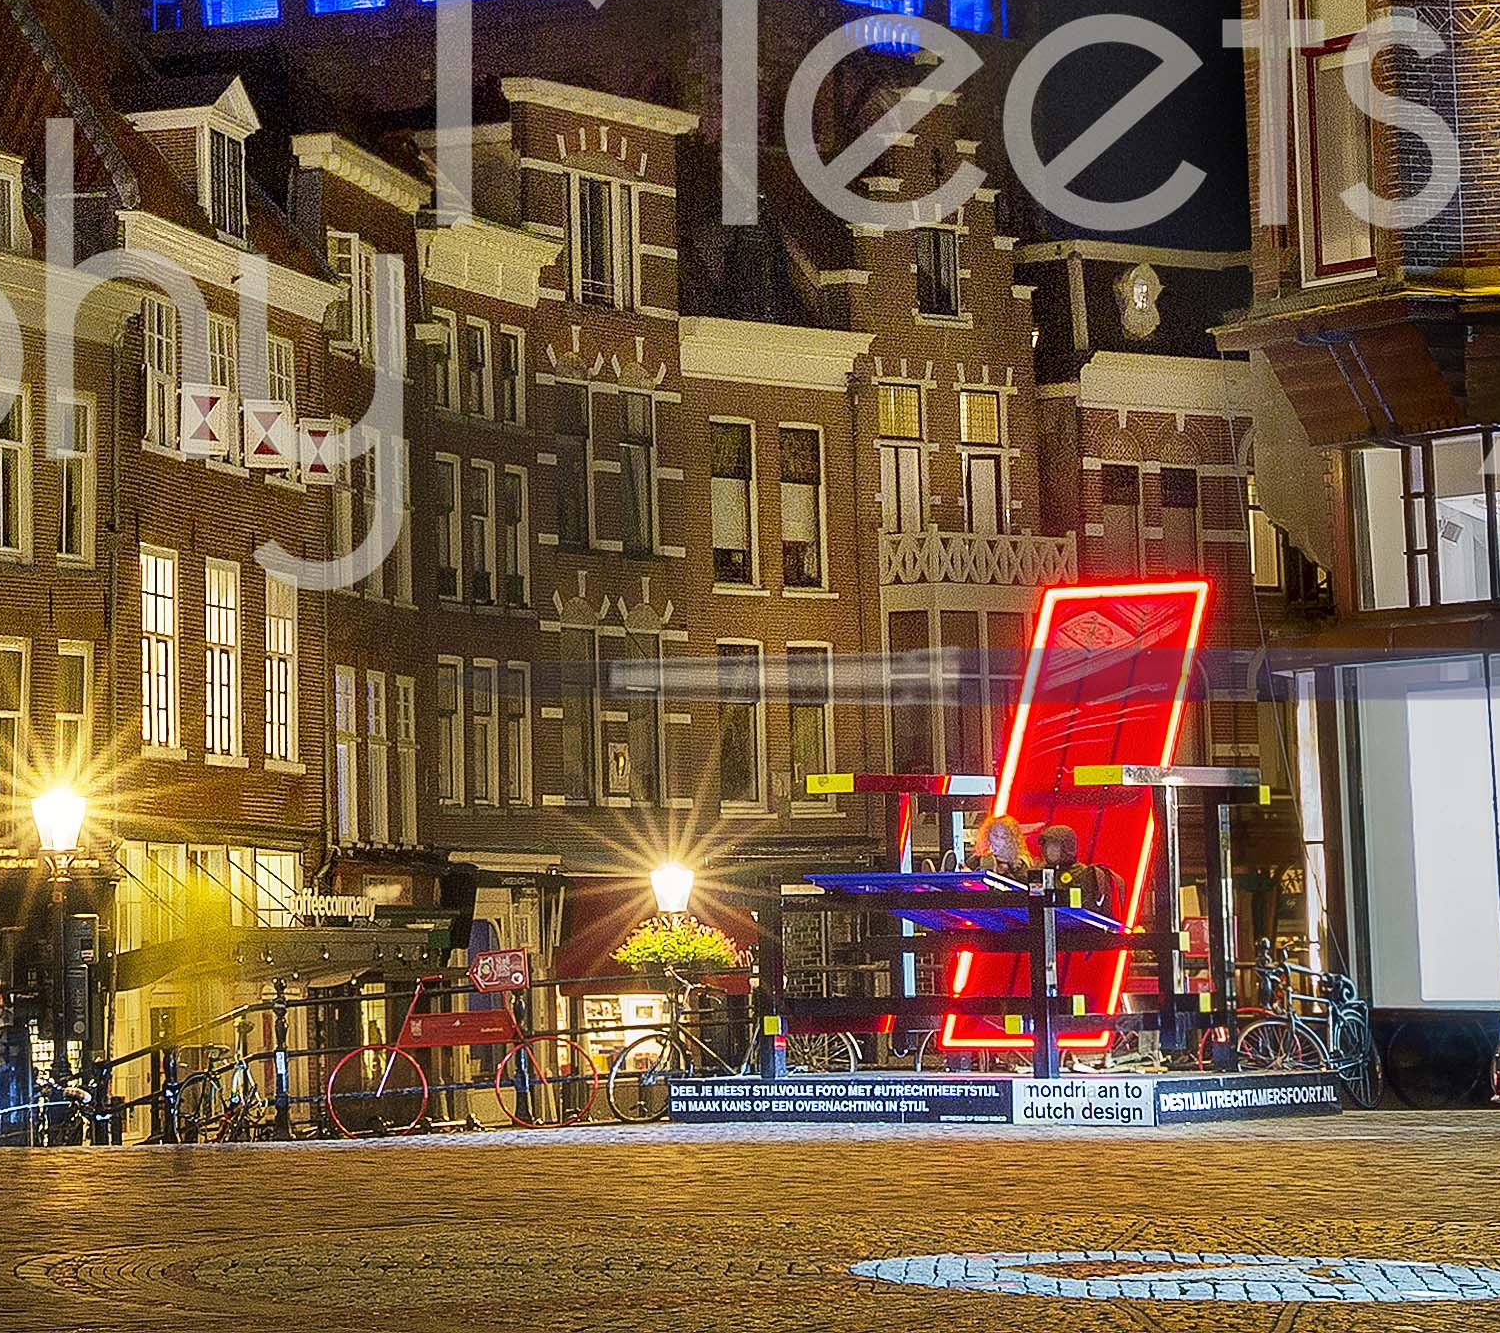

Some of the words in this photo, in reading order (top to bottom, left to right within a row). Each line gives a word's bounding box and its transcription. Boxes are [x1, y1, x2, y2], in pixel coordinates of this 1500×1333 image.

[670, 1085, 699, 1097] DEEL
[700, 1085, 713, 1097] JE
[714, 1084, 751, 1097] MEEST
[752, 1084, 814, 1097] STIJLVOLLE
[816, 1085, 847, 1097] FOTO
[848, 1085, 873, 1097] MET
[1125, 1084, 1143, 1099] to
[671, 1100, 687, 1112] EN
[688, 1100, 721, 1112] MAAK
[721, 1100, 752, 1112] KANS
[753, 1100, 771, 1112] OP
[771, 1100, 794, 1112] EEN
[795, 1100, 884, 1113] OVERNACHTING
[885, 1100, 898, 1112] IN
[899, 1100, 930, 1113] STIJL
[1023, 1101, 1076, 1121] dutch
[1081, 1101, 1144, 1124] design
